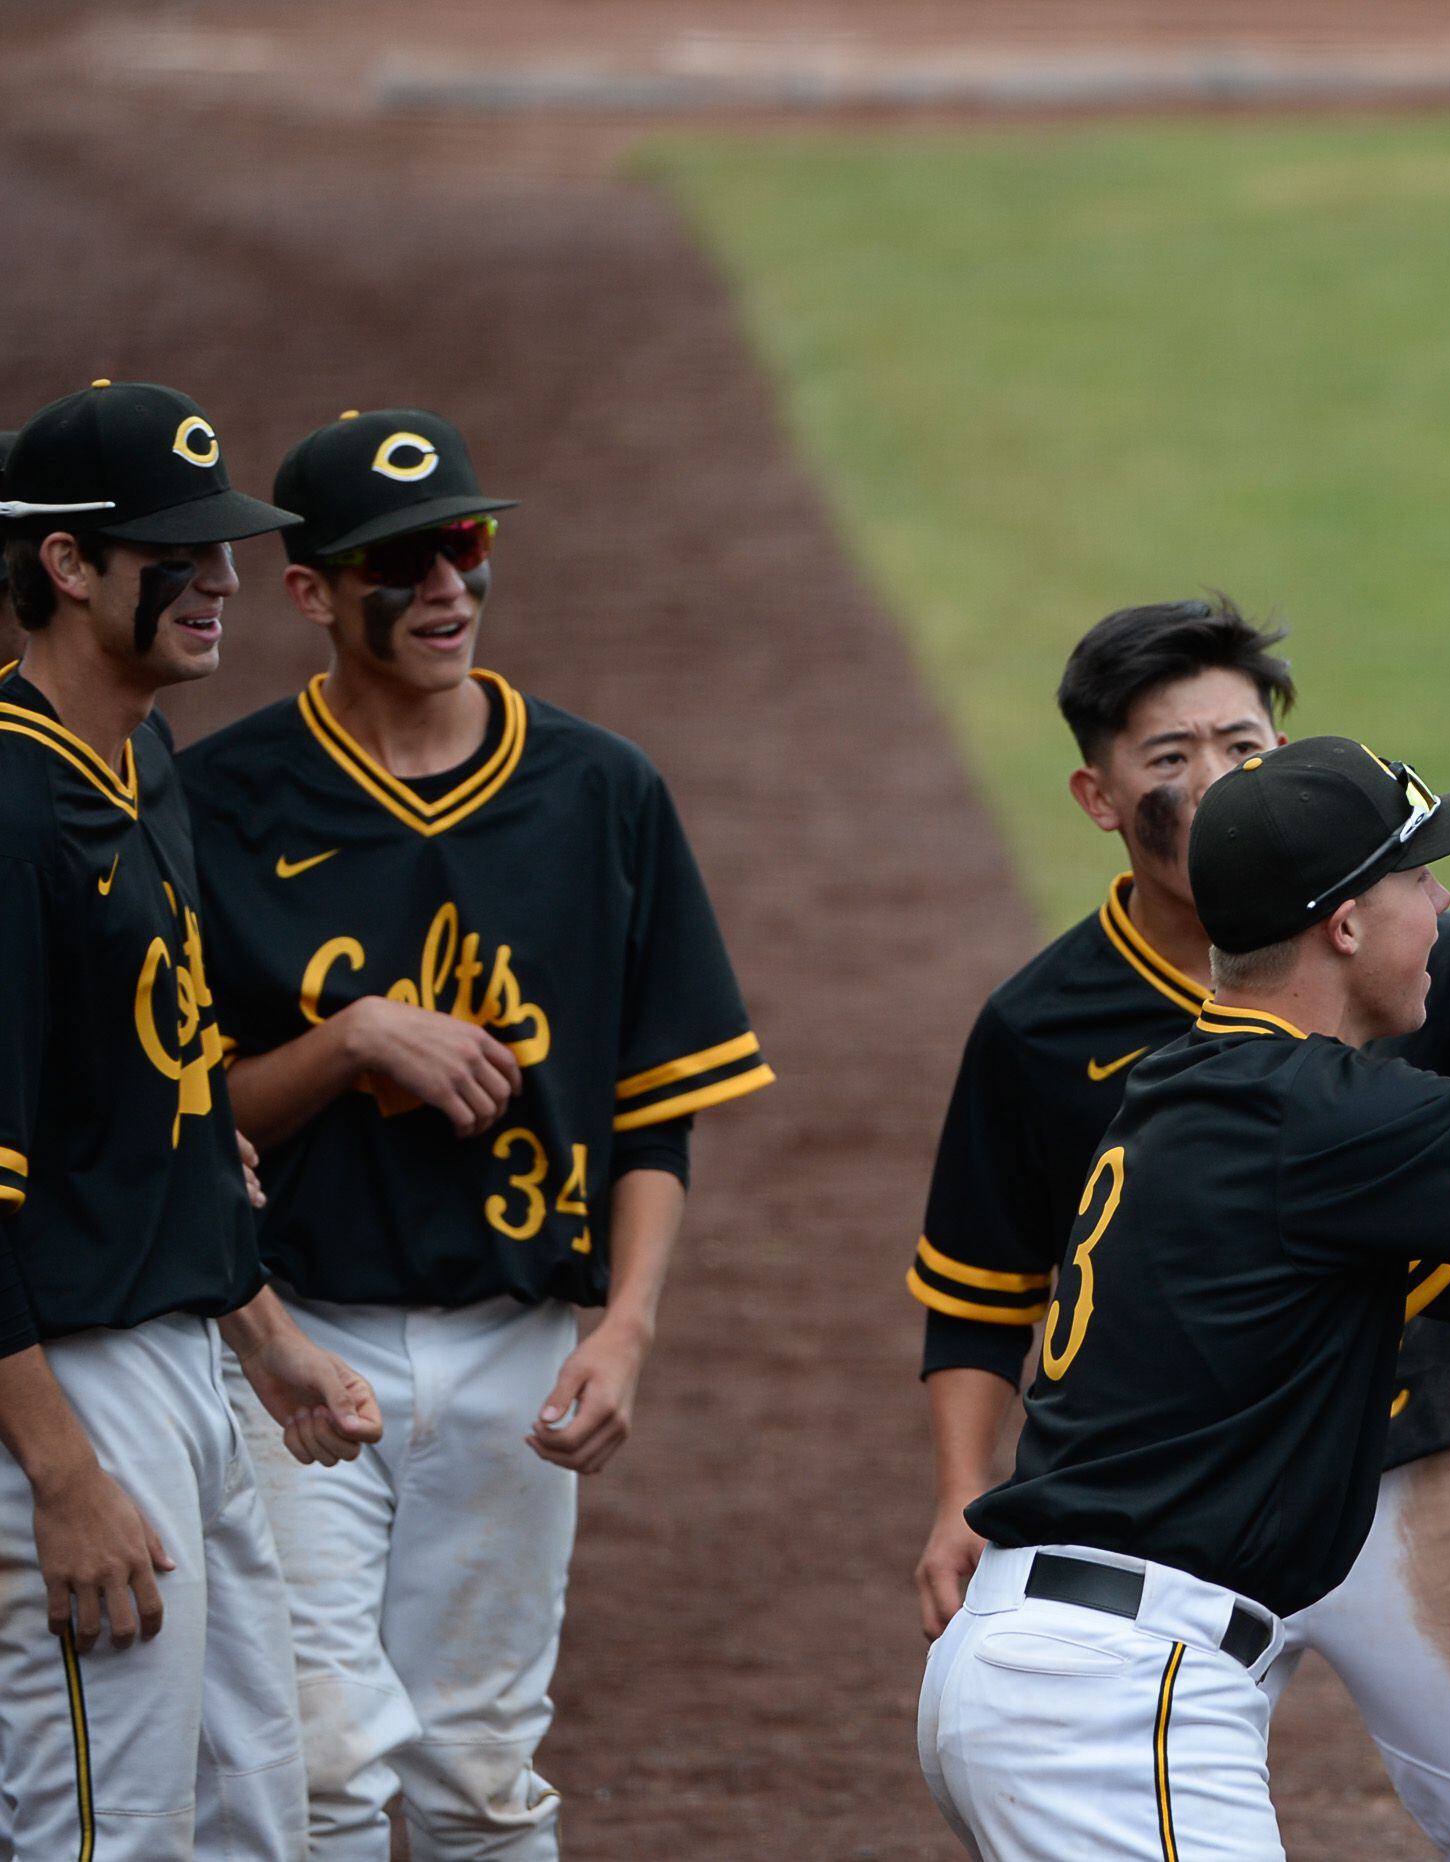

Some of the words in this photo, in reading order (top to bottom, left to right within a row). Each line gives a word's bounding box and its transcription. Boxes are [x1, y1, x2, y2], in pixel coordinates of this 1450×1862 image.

[172, 416, 220, 467] C
[371, 431, 440, 482] C
[485, 1128, 591, 1253] 34
[1043, 1146, 1125, 1381] 3
